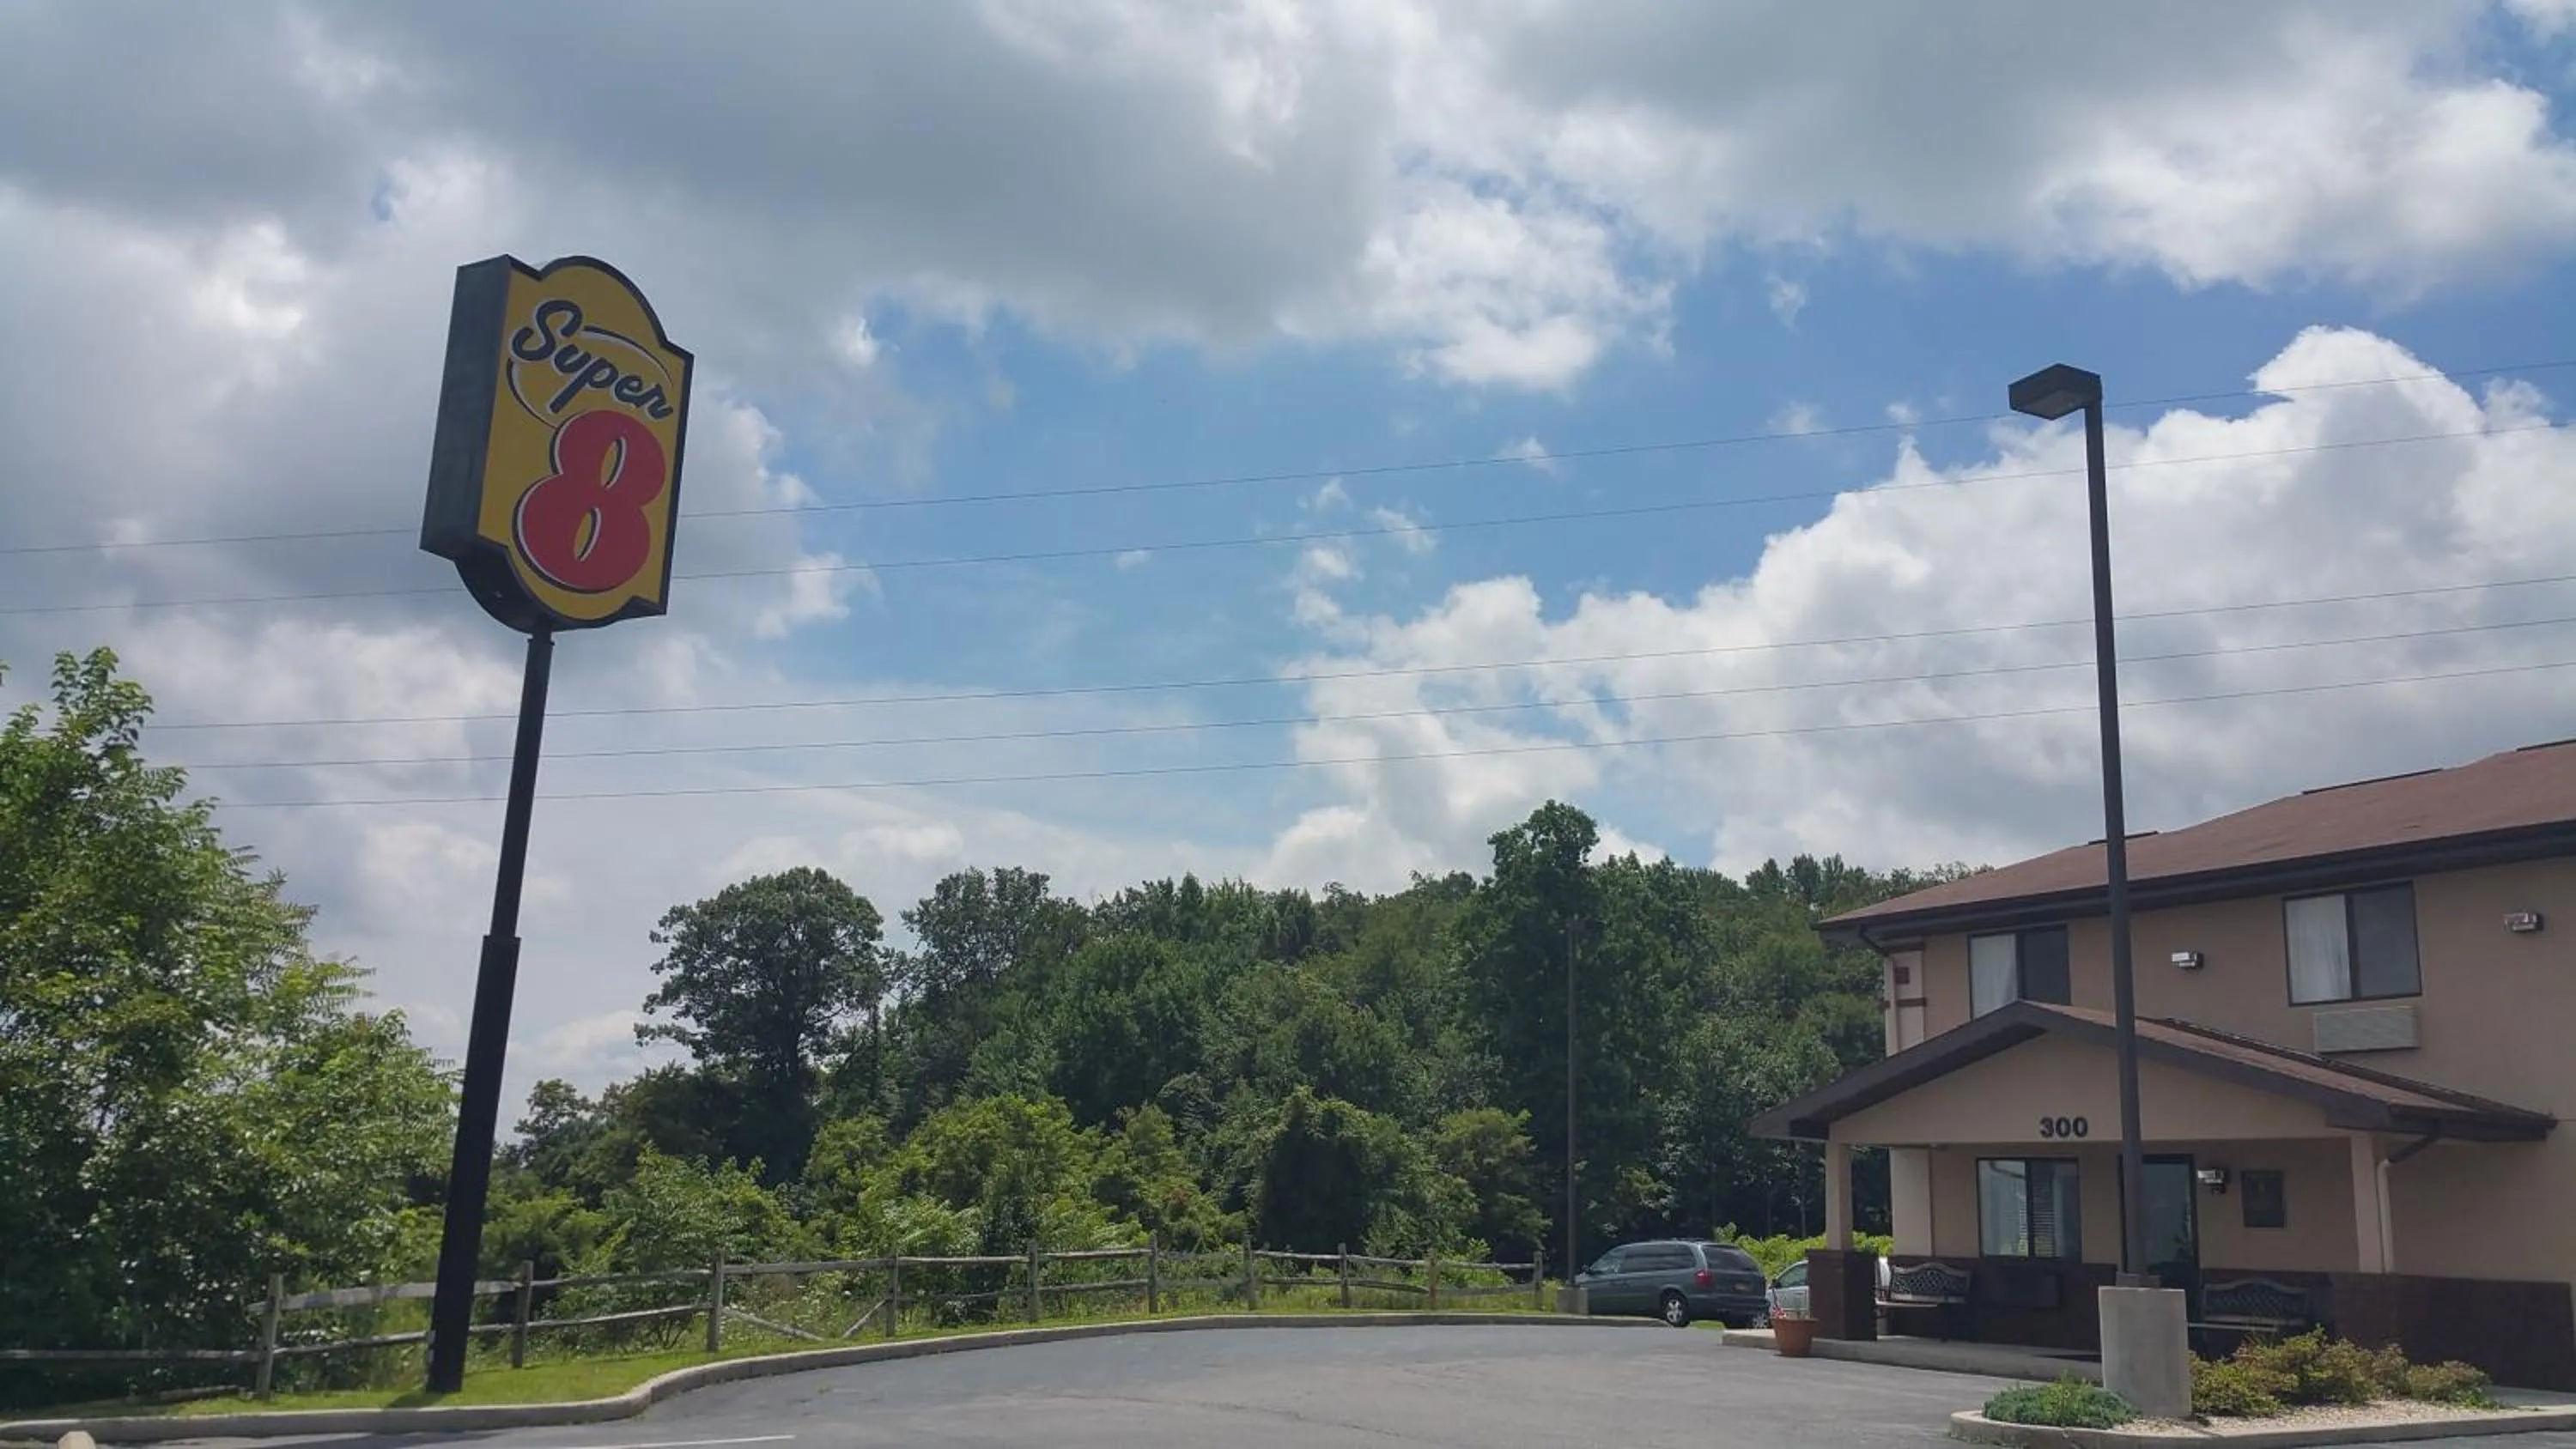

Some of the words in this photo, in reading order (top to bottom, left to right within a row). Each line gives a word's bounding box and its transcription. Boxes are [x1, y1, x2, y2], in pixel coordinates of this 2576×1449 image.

[513, 300, 673, 419] Super
[513, 409, 666, 593] 8
[2039, 1117, 2088, 1138] 300
